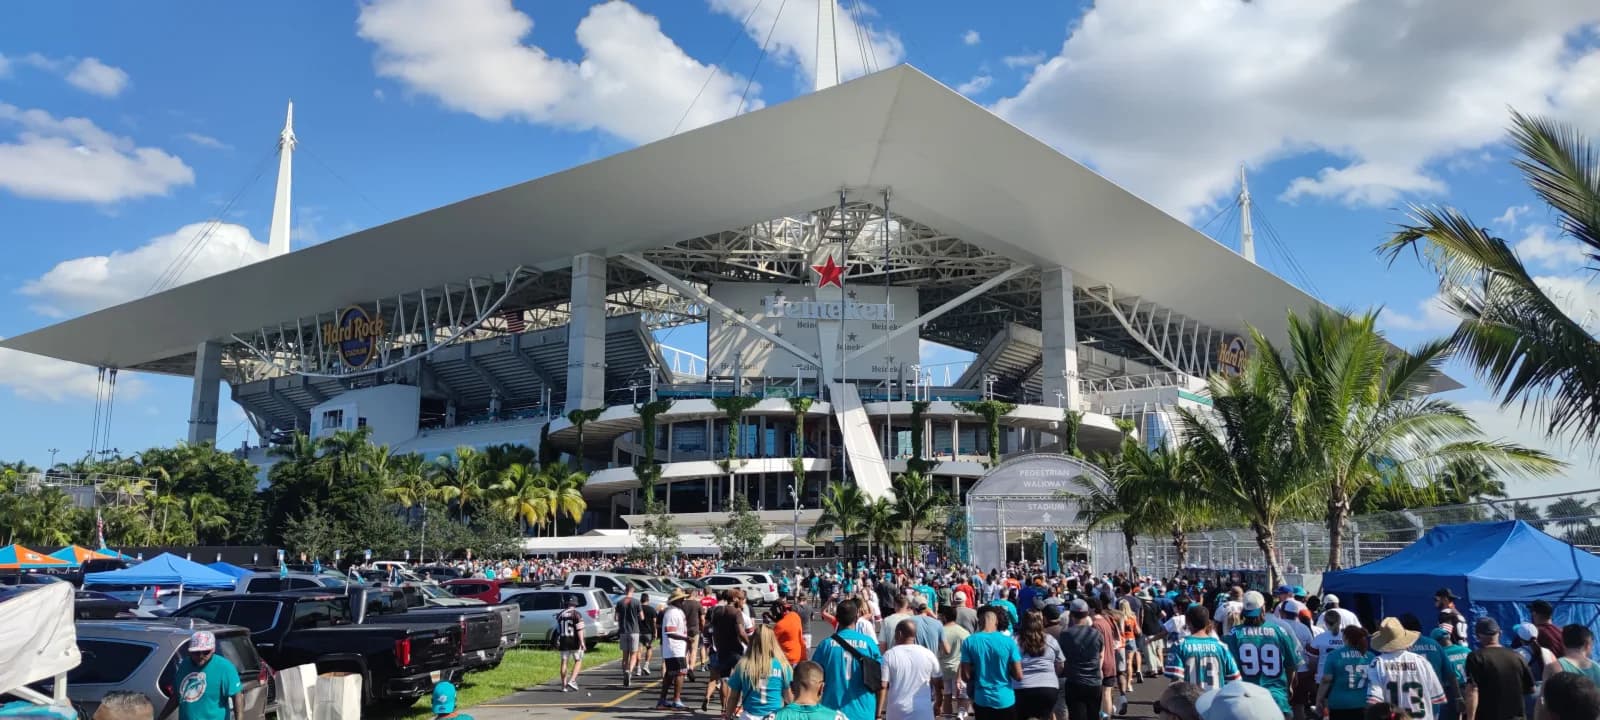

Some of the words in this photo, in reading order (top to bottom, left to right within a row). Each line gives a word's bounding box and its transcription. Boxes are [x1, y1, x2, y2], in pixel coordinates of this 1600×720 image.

[764, 295, 895, 321] Heineken
[323, 319, 352, 345] Hard
[353, 313, 384, 342] Rock
[1219, 343, 1239, 366] Hard
[1023, 480, 1066, 488] WALKWAY
[1028, 503, 1065, 511] STADIUM
[1242, 626, 1276, 637] TAYLOR
[1238, 642, 1281, 677] 99
[1185, 656, 1220, 689] 13
[1344, 664, 1369, 689] 17
[1385, 681, 1427, 719] 13
